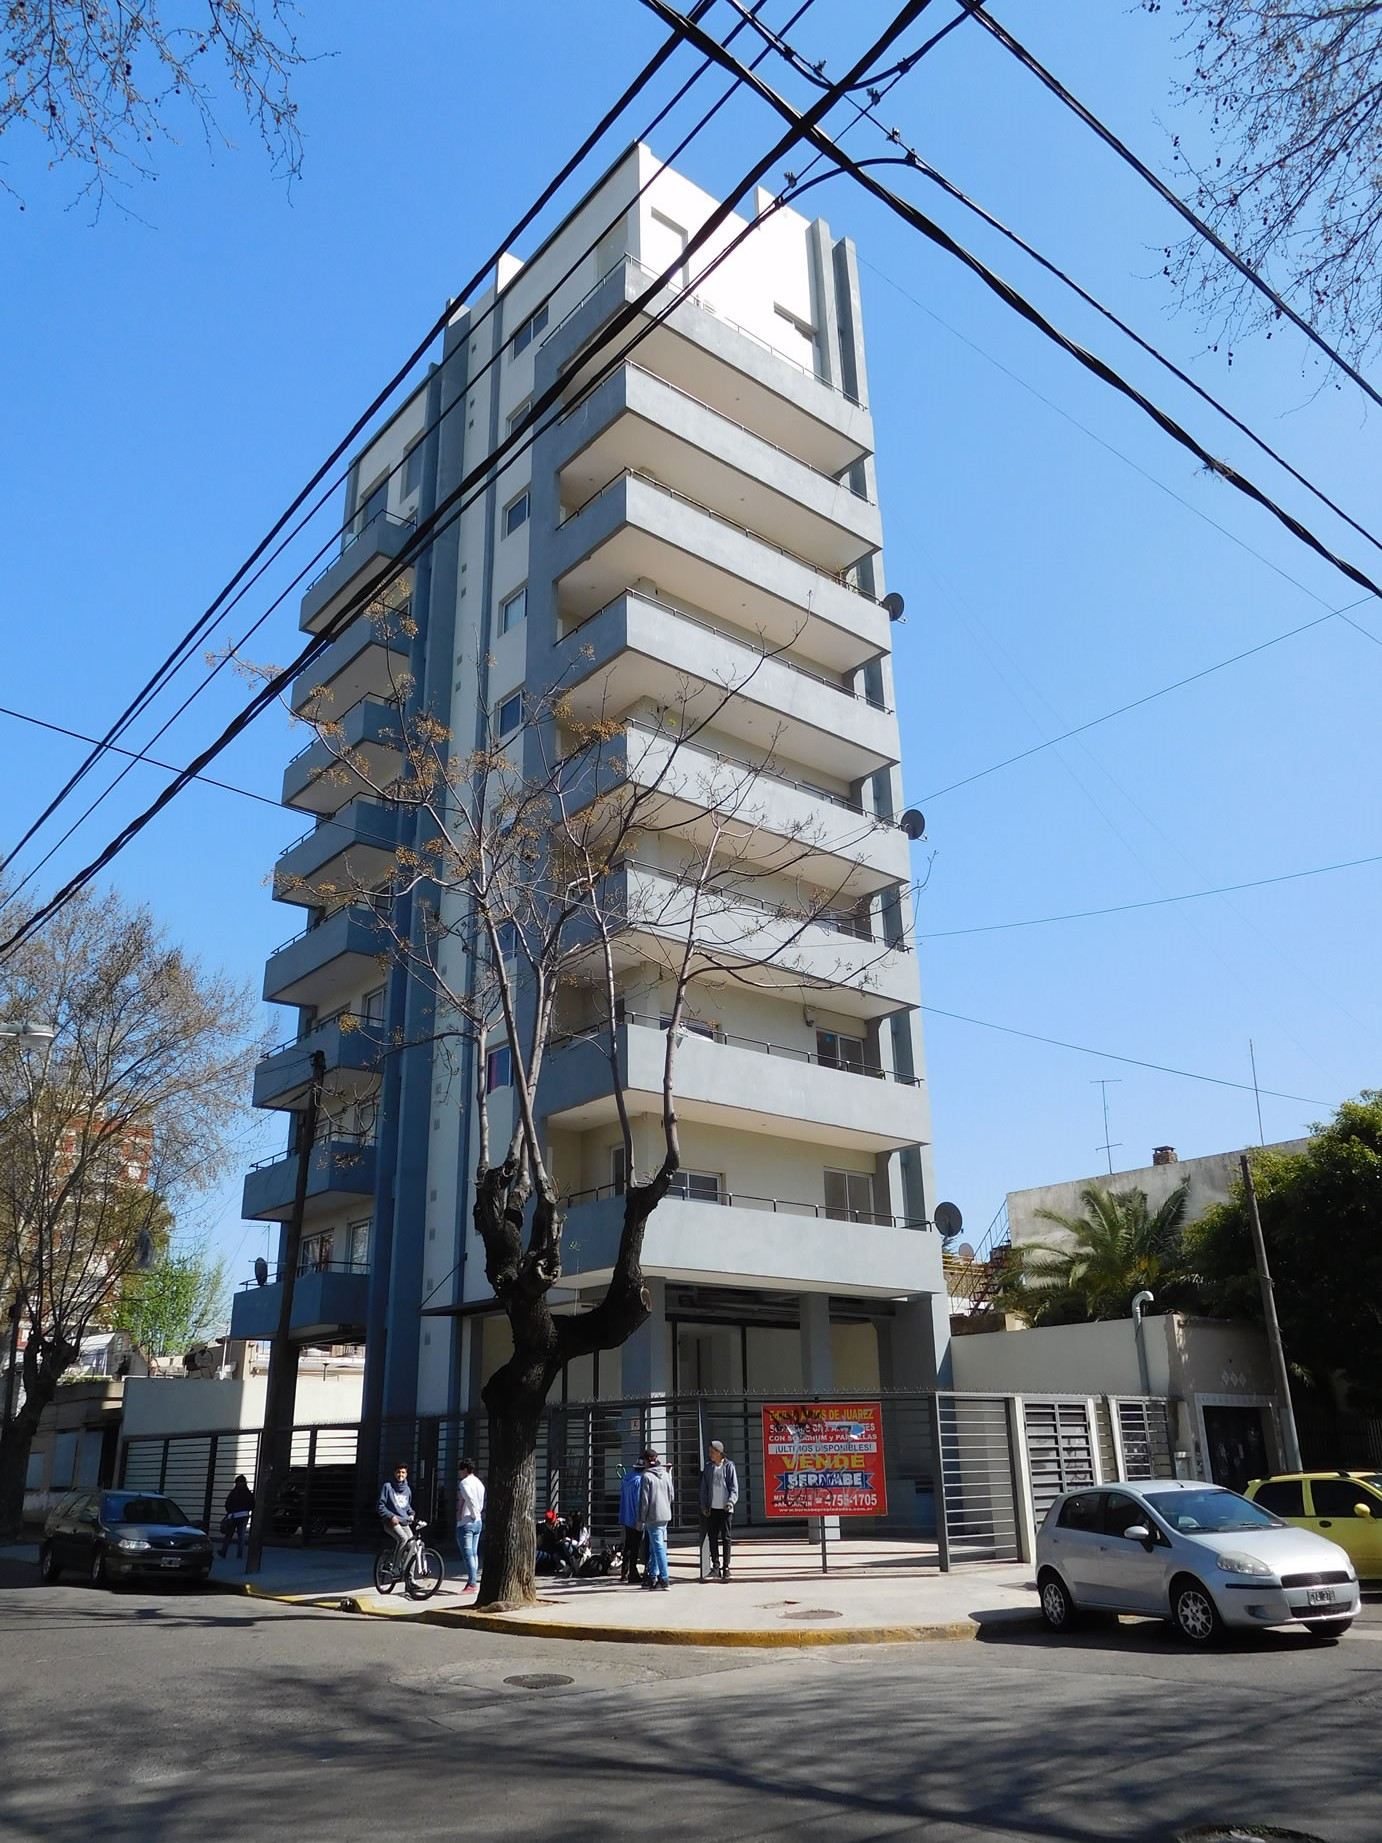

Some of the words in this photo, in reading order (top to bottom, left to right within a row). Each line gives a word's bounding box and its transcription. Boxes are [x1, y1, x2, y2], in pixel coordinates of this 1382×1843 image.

[828, 1409, 840, 1420] DE
[843, 1408, 874, 1420] JUAREZ
[787, 1434, 827, 1442] SARIUM
[835, 1433, 878, 1441] PARLLAS
[782, 1455, 865, 1469] VENDE
